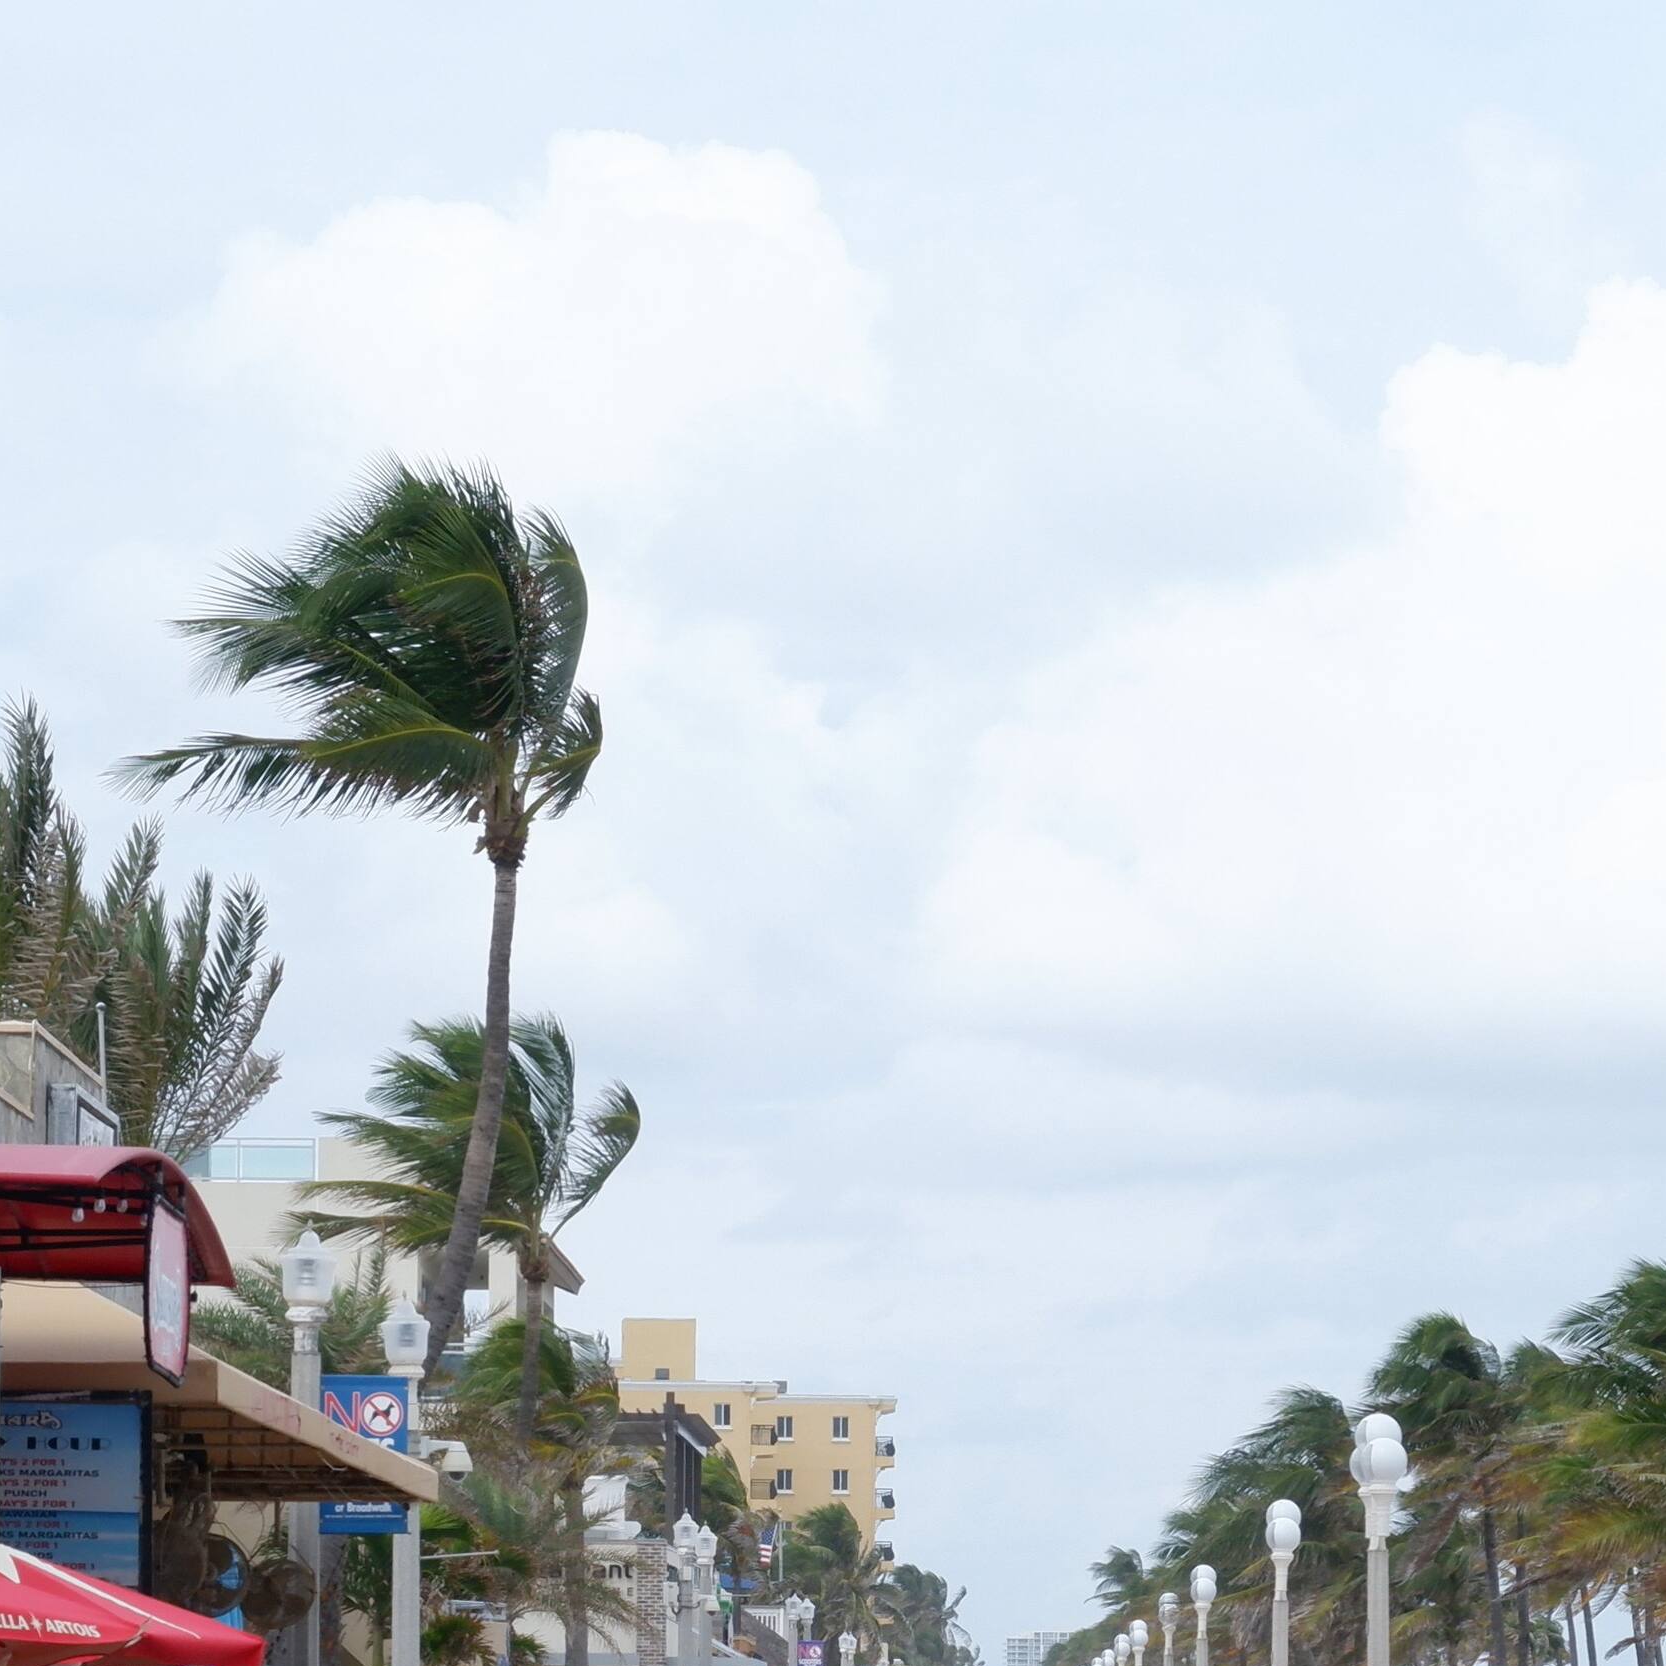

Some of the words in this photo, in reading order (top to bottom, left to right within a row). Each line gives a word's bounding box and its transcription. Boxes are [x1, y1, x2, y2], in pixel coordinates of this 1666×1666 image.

[27, 1437, 111, 1450] HOUR
[19, 1469, 100, 1478] MARGARITAS
[4, 1489, 48, 1497] PUNCH
[42, 1500, 67, 1508] FOR
[18, 1531, 99, 1539] MARGARITAS
[45, 1618, 101, 1638] ARTOIS
